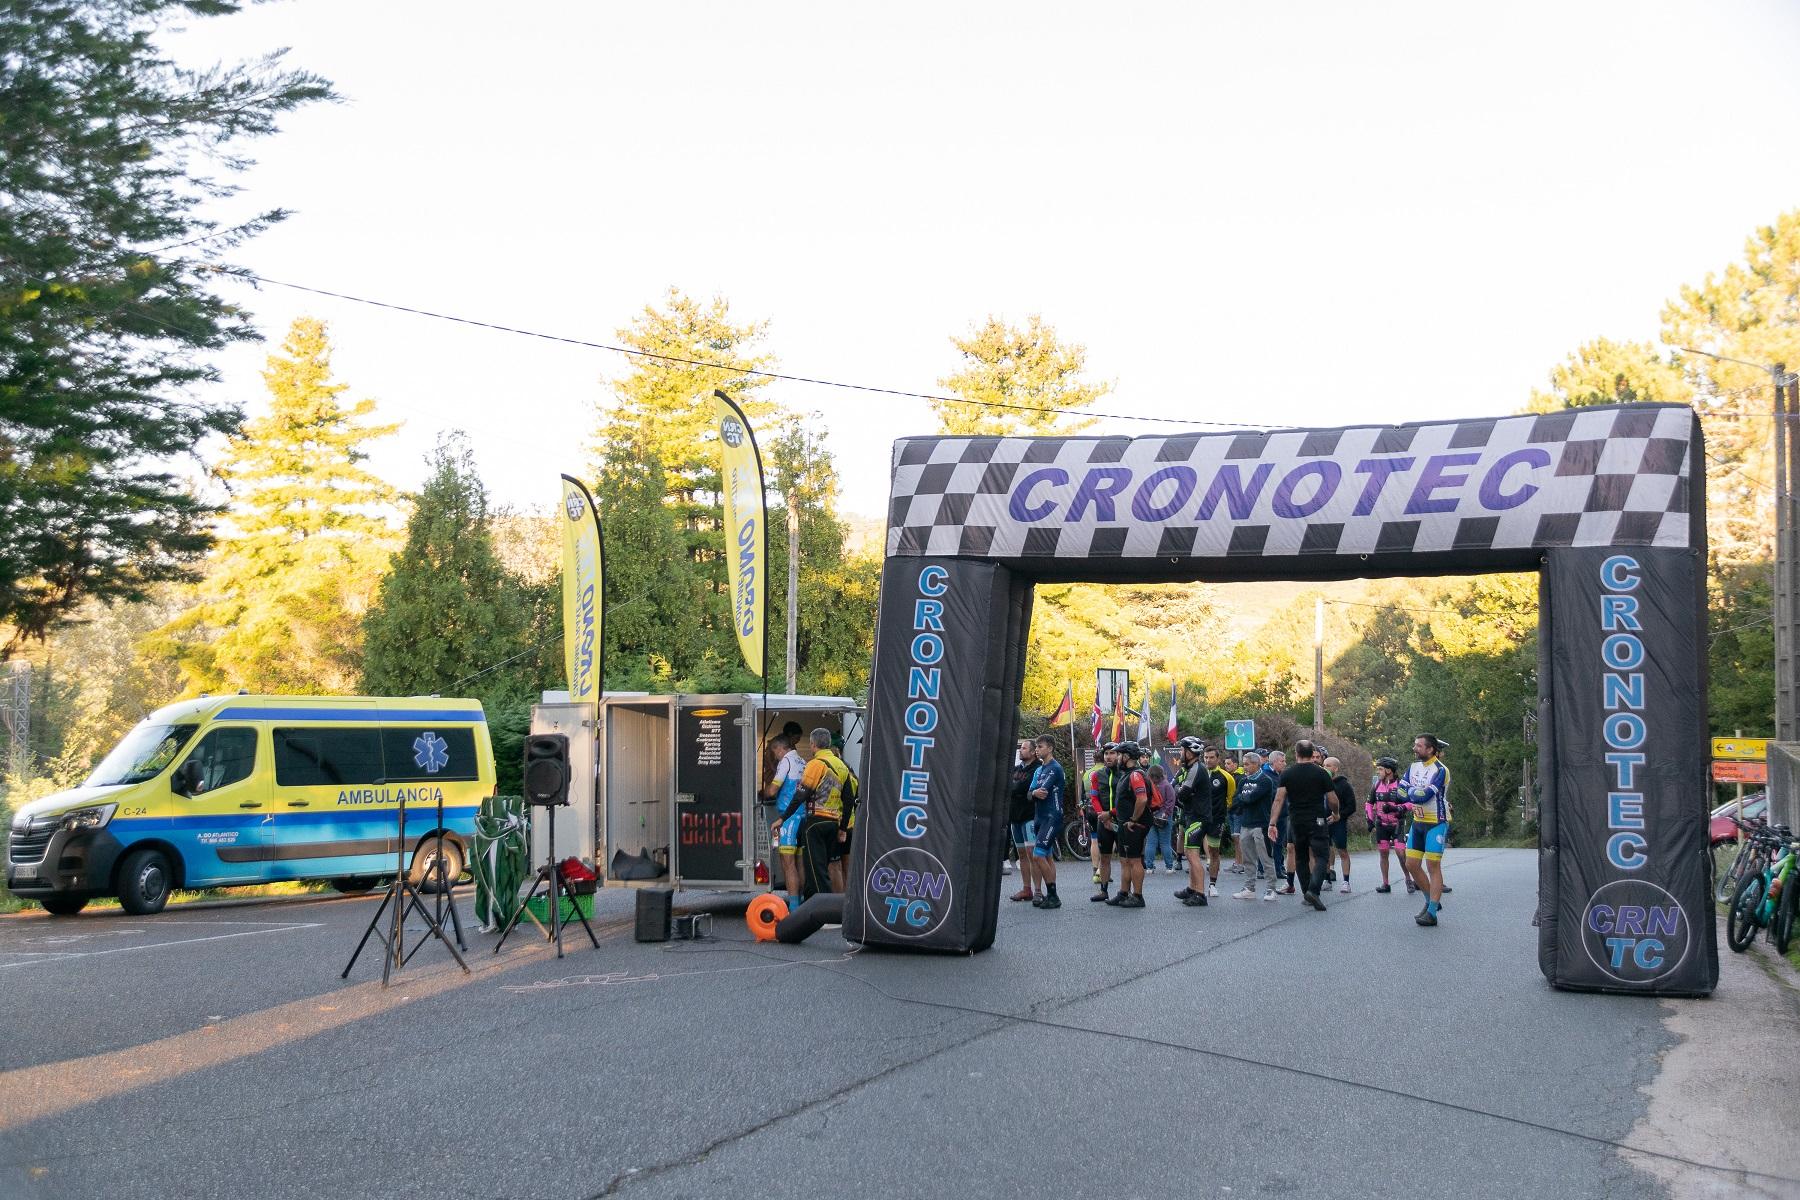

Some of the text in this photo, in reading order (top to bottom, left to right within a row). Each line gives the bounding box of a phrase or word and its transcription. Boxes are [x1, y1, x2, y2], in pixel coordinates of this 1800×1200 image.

[1008, 448, 1551, 522] CRONOTEC
[895, 565, 949, 838] CRONOTEC
[1600, 555, 1648, 870] CRONOTEC
[1234, 722, 1245, 737] C
[124, 807, 147, 815] C-24
[337, 787, 443, 805] AMBULANCIA
[871, 867, 947, 900] CRN
[884, 897, 931, 927] TC
[1588, 904, 1680, 936] CRN
[1605, 938, 1666, 969] TC
